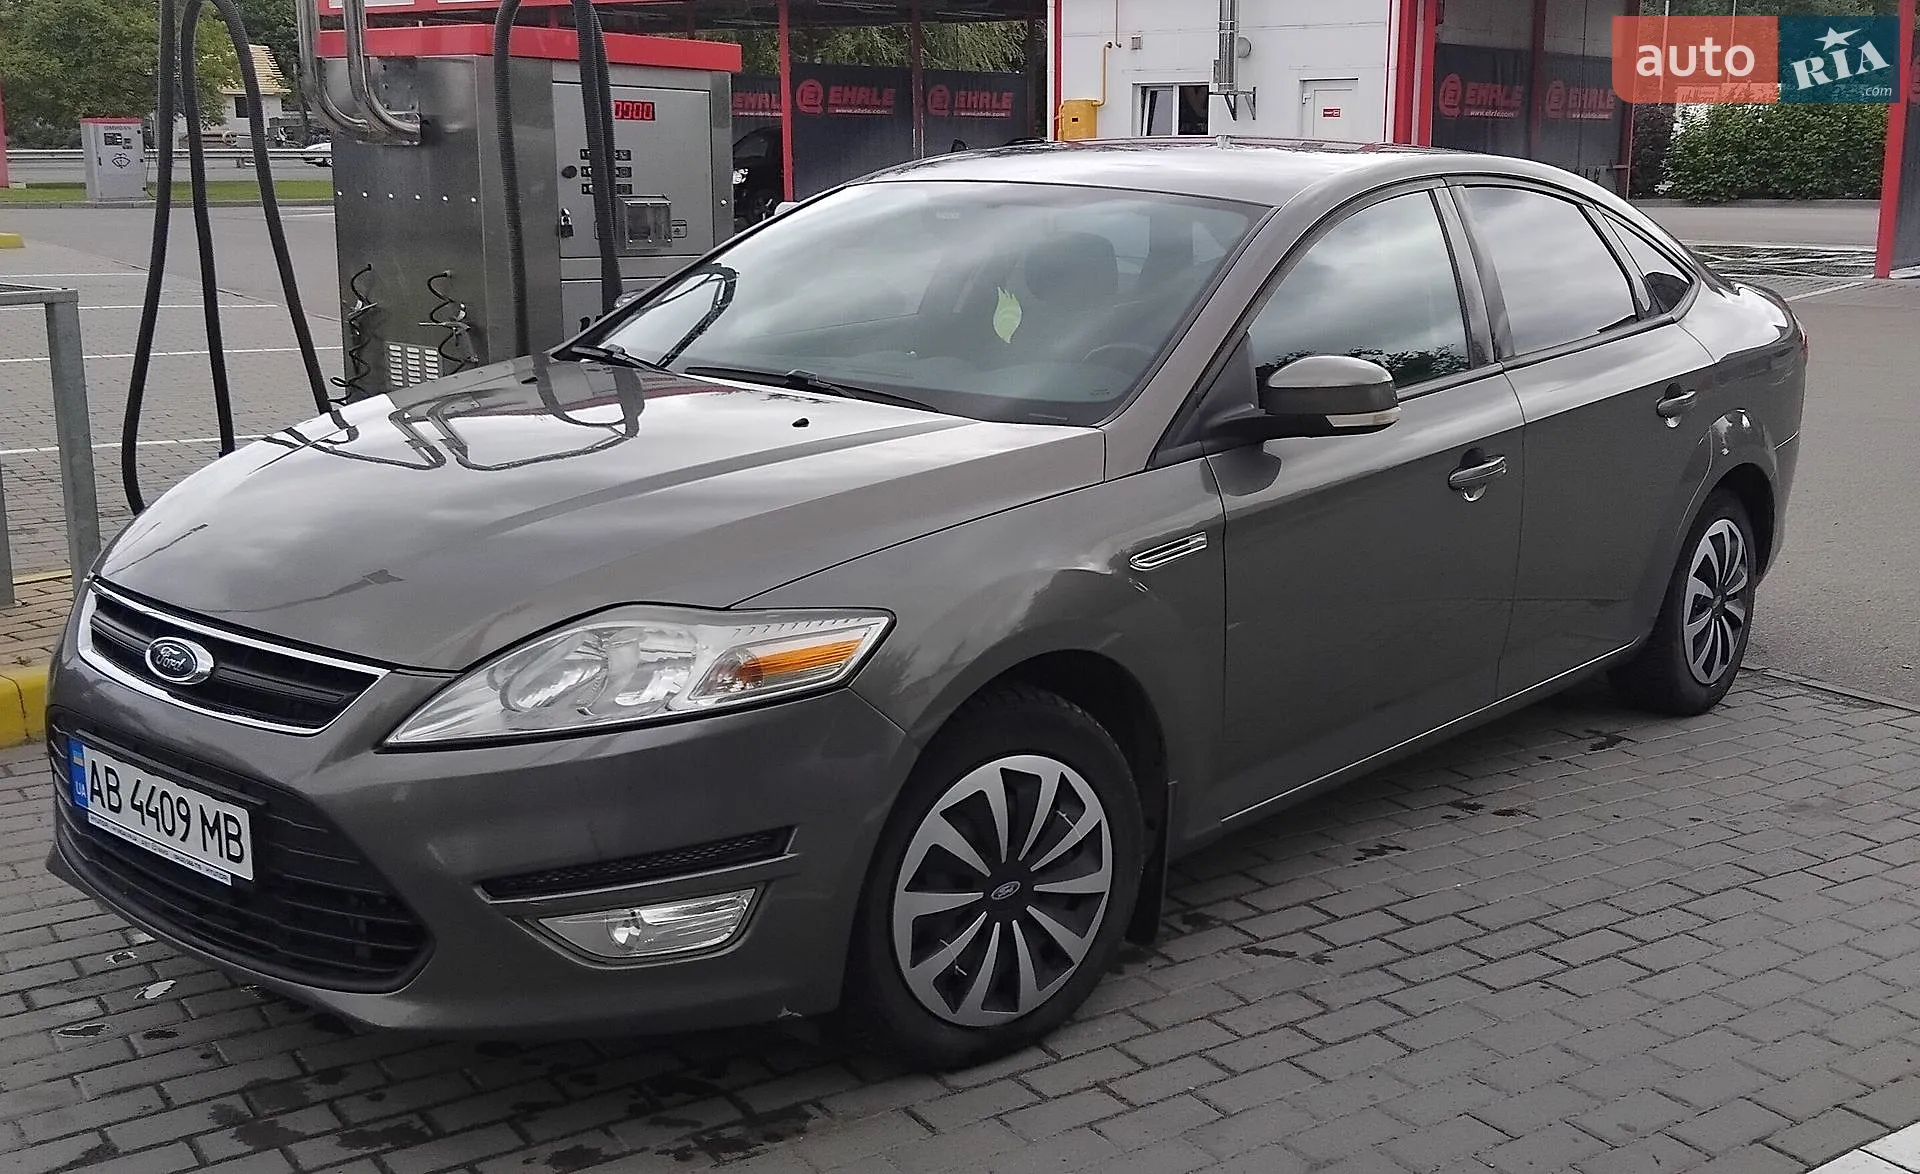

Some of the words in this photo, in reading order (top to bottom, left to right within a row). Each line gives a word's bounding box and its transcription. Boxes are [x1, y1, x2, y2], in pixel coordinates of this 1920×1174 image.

[732, 92, 781, 110] EHRL
[828, 85, 896, 106] EHRLE
[955, 90, 1014, 109] EHRLE
[156, 646, 187, 672] Ford
[75, 781, 87, 798] UA
[90, 760, 122, 814] AB
[131, 779, 191, 842] 4409
[199, 803, 244, 864] MB
